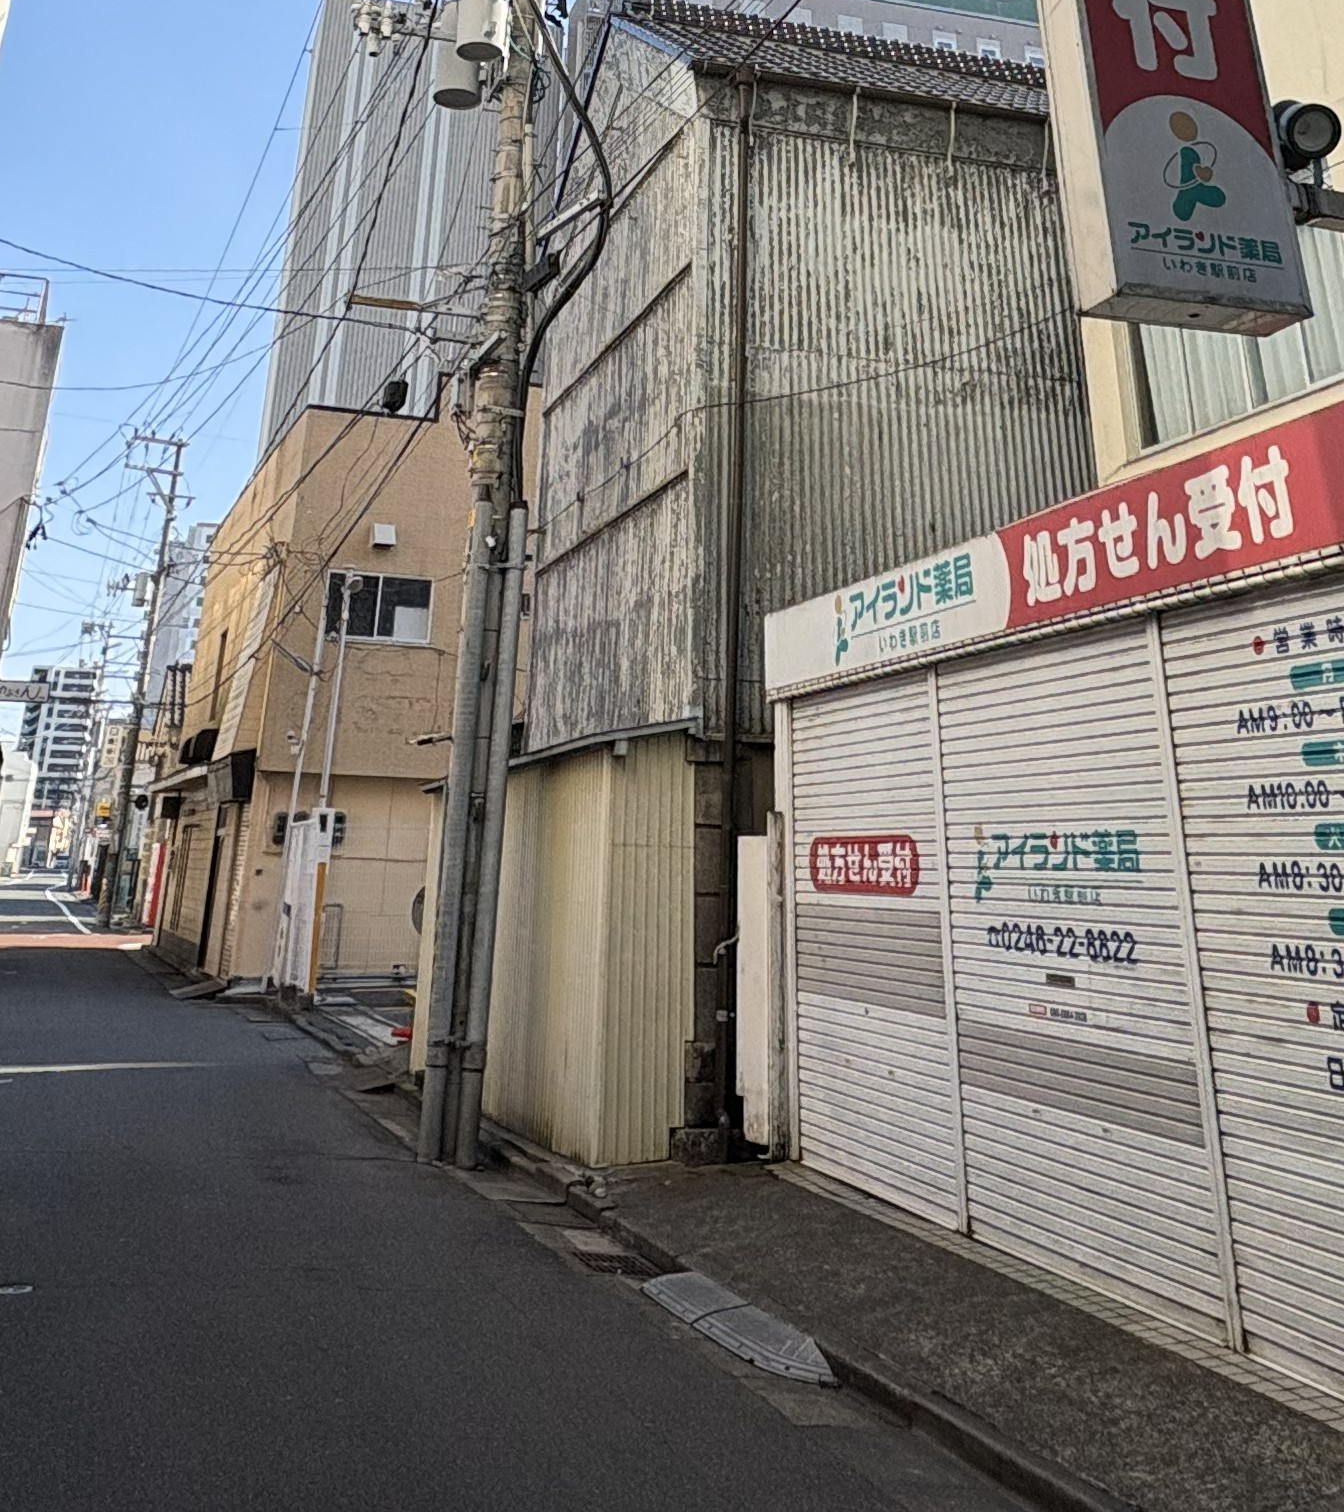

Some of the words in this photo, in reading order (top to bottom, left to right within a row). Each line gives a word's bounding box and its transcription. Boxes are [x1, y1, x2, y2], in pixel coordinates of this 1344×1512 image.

[1128, 221, 1282, 264] アイランド薬局
[1163, 256, 1258, 282] いわき駅前店
[1023, 445, 1294, 606] 処方せん受付
[849, 553, 974, 632] アイランド薬局
[878, 620, 941, 653] いわき駅前店
[991, 829, 1142, 873] アイランド薬局
